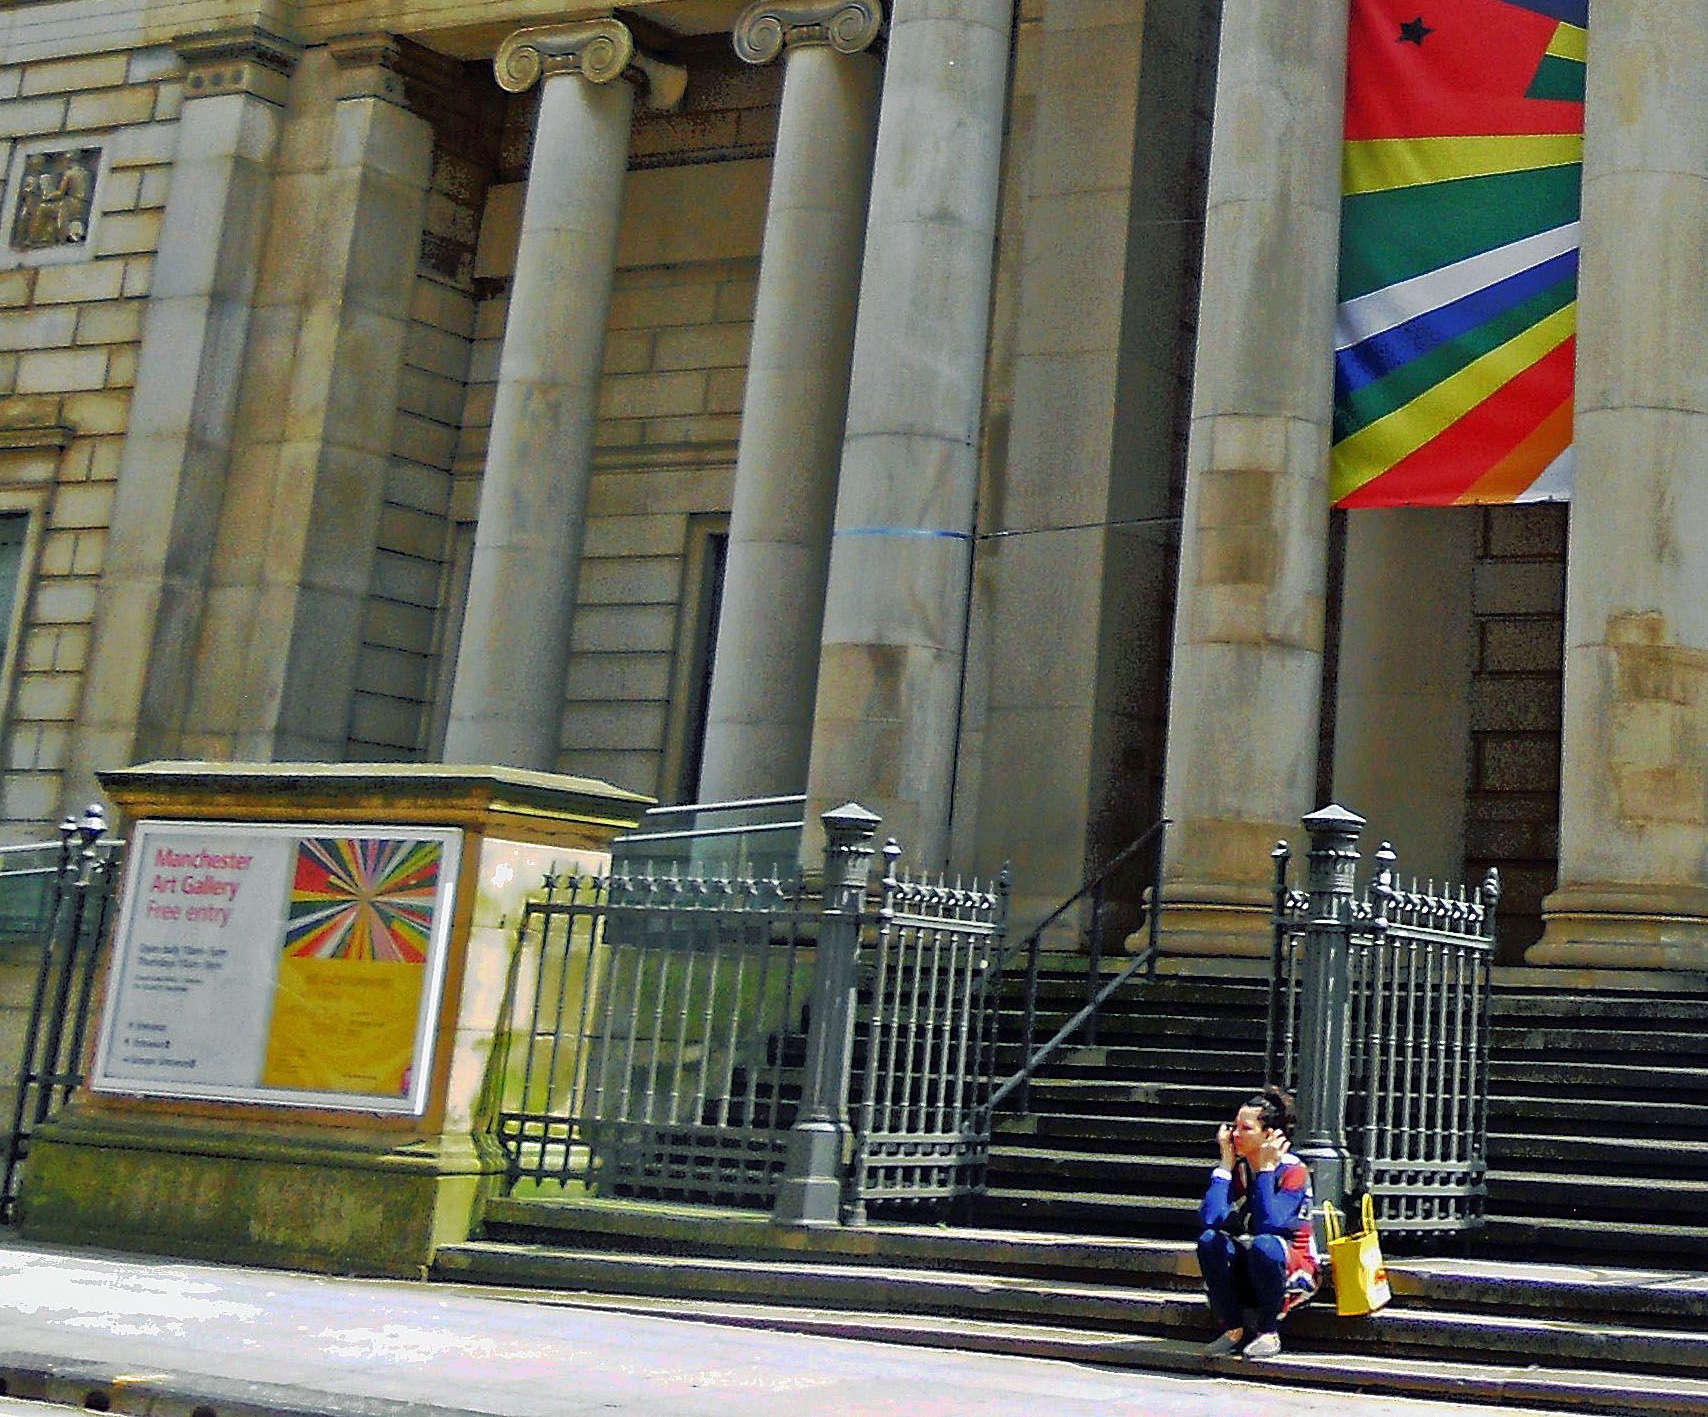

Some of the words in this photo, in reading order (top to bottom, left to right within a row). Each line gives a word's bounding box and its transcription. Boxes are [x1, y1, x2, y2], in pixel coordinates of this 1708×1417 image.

[154, 848, 254, 870] Manchester
[151, 874, 177, 894] Art
[182, 874, 241, 902] Gallery
[147, 899, 181, 920] Free
[186, 905, 230, 928] entry
